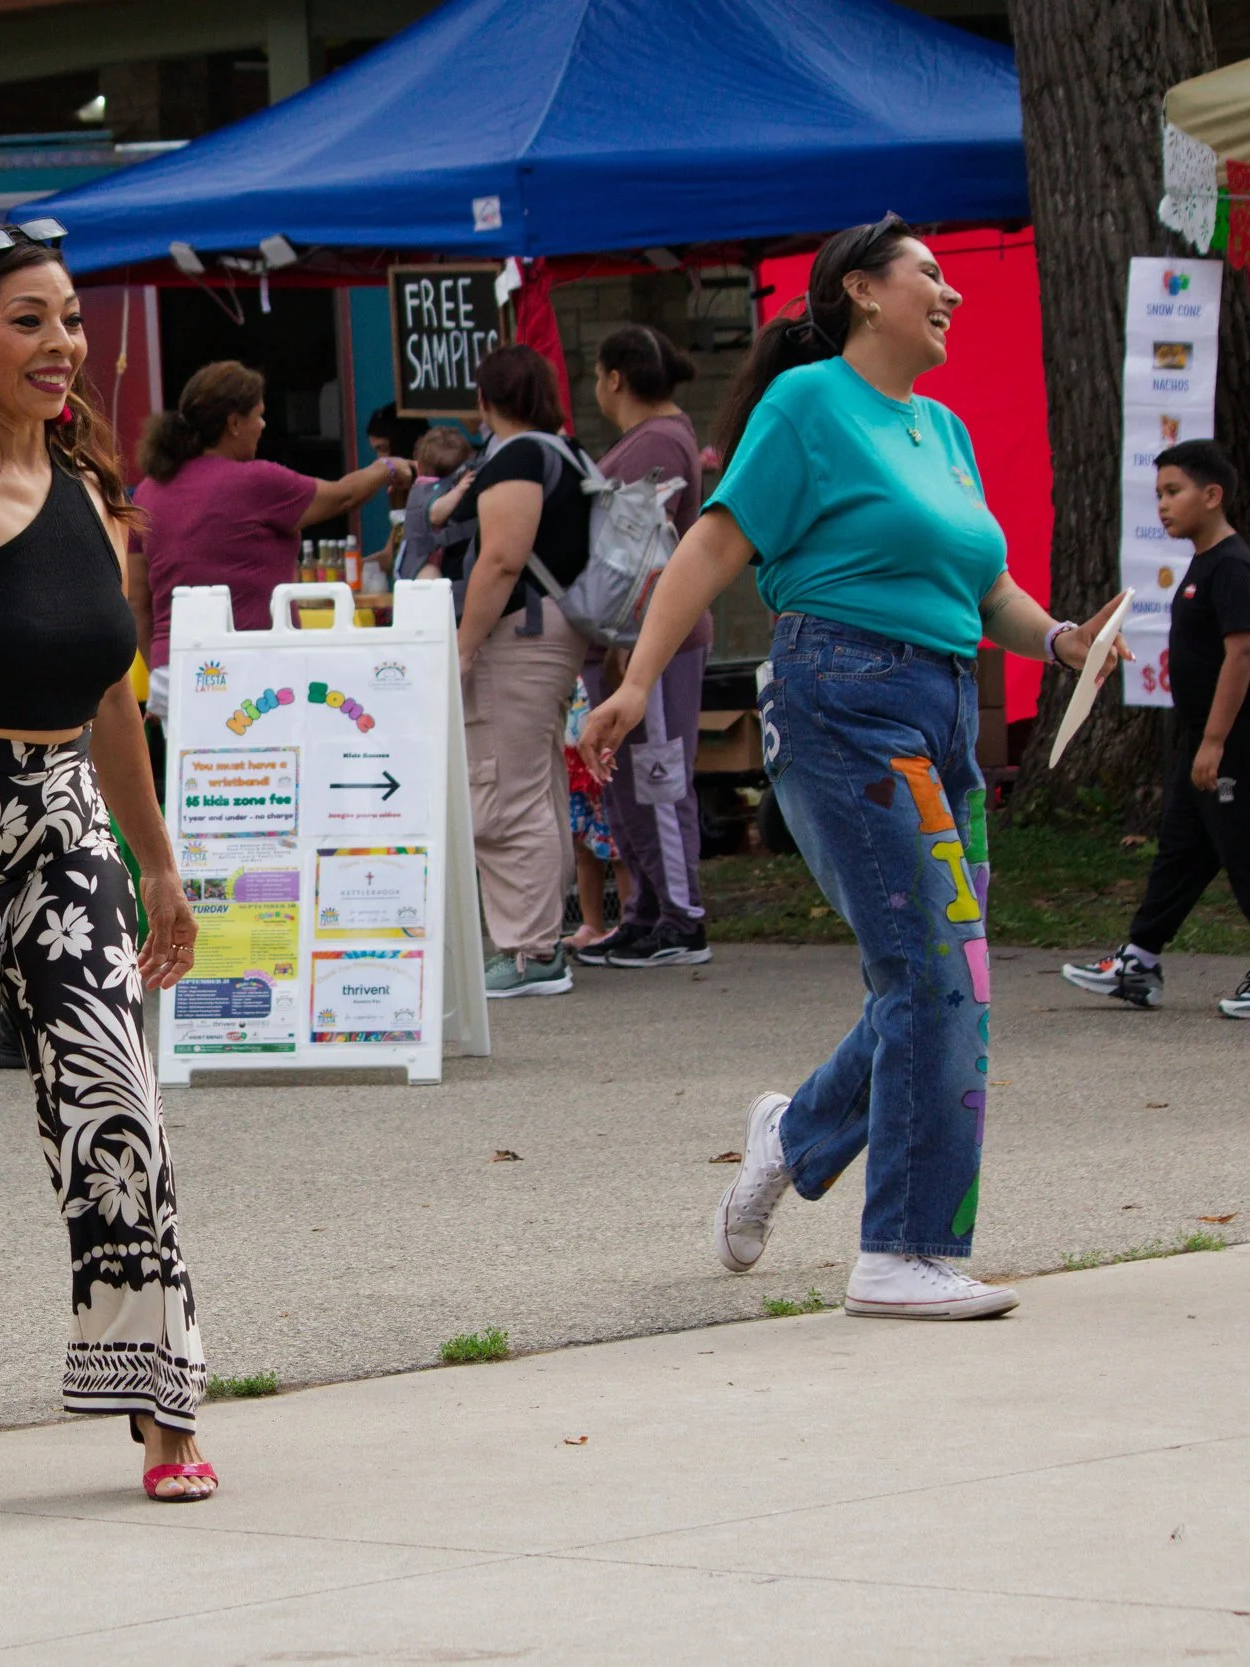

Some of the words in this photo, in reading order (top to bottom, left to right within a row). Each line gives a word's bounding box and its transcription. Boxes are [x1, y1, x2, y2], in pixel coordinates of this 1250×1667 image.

[404, 277, 475, 329] FREE
[1146, 303, 1175, 316] SNOW
[1177, 304, 1203, 317] CONE
[1153, 377, 1190, 392] NACHOS
[196, 674, 227, 686] FIESTA
[192, 760, 214, 771] You
[215, 760, 246, 770] must
[248, 759, 277, 770] have
[279, 761, 287, 769] a
[185, 795, 200, 808] $5
[202, 794, 230, 806] kids
[232, 796, 266, 806] zone
[269, 792, 292, 805] fee
[188, 815, 207, 823] year
[208, 813, 223, 821] and
[266, 811, 294, 821] charge
[191, 904, 230, 915] TURDAY
[342, 984, 390, 996] thrivent
